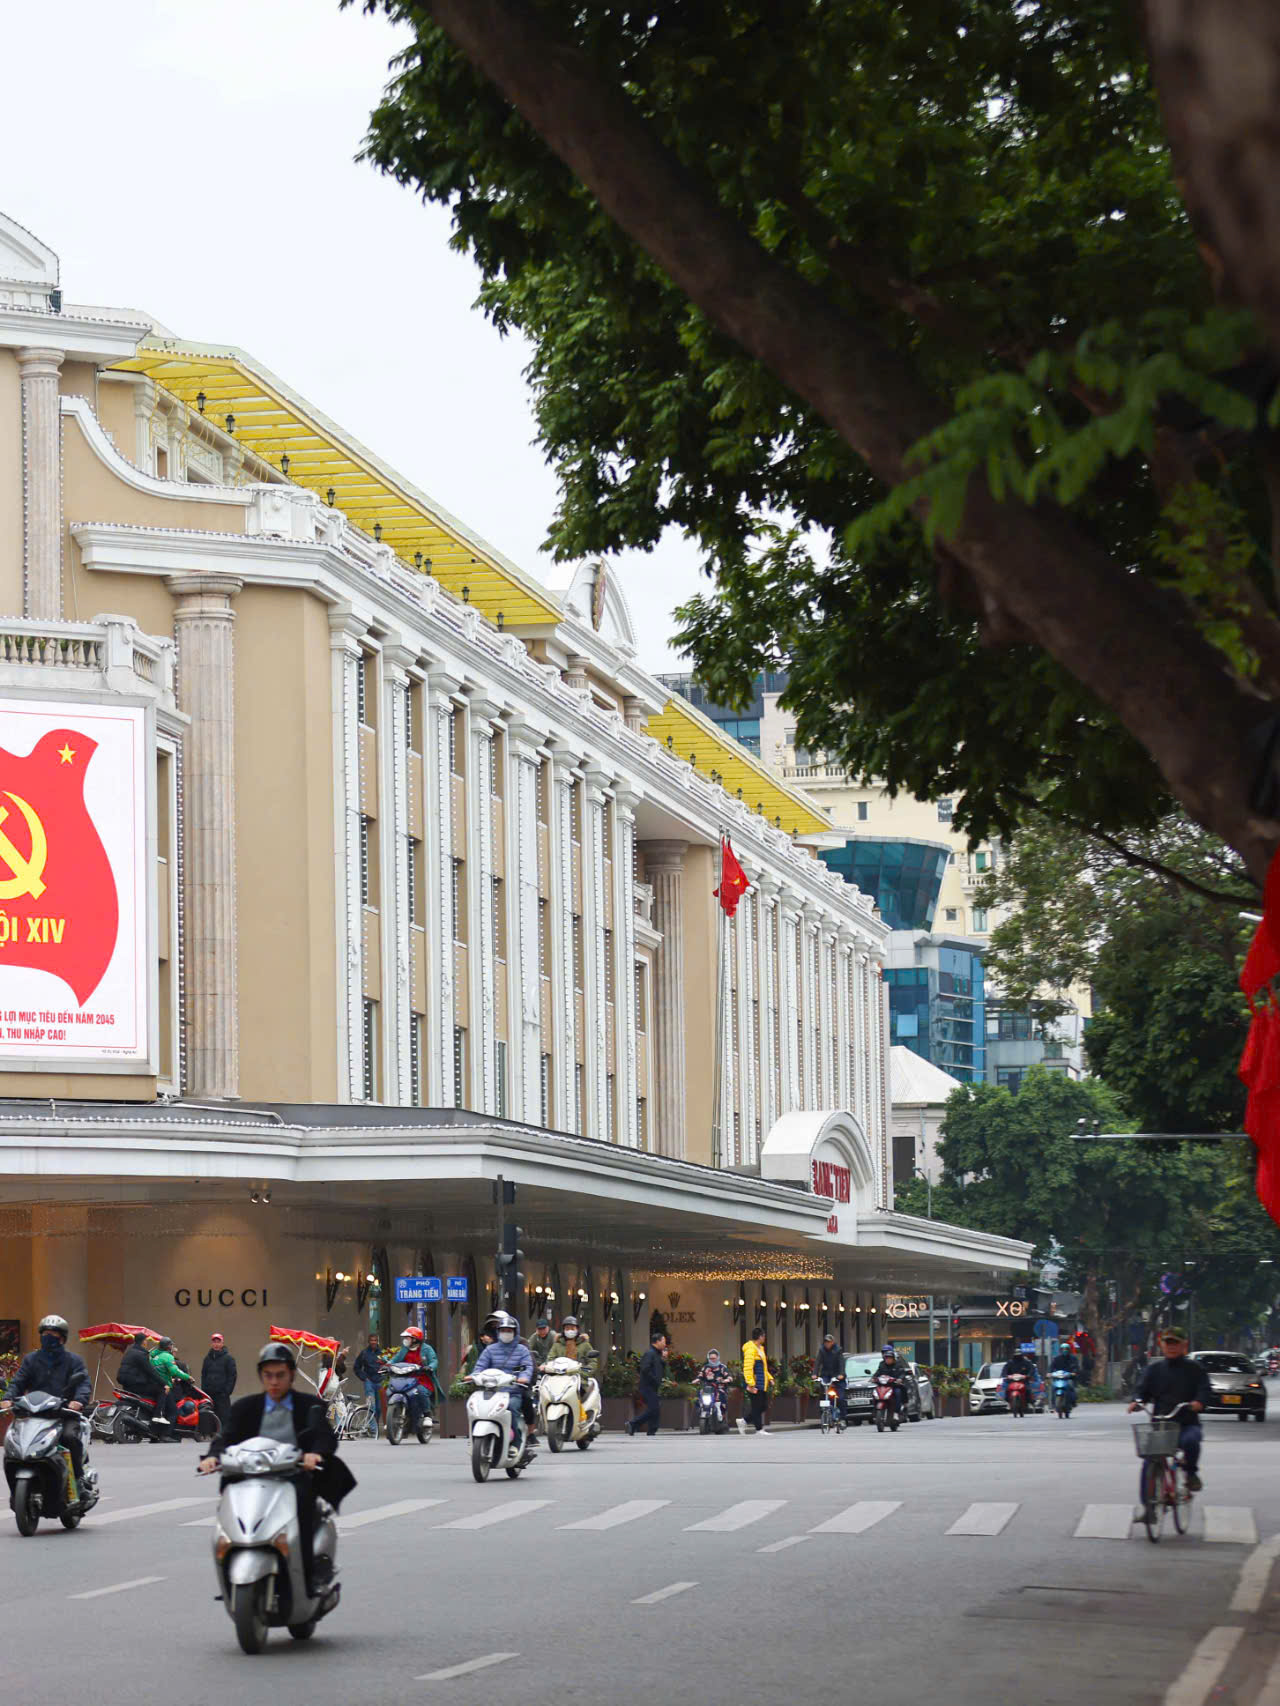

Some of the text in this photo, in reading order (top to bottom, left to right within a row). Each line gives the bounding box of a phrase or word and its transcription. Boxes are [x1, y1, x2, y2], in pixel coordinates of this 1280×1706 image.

[26, 918, 65, 943] XIV
[19, 1011, 37, 1024] MỤC
[39, 1010, 55, 1023] TIÊU
[57, 1009, 73, 1023] ĐẾN
[96, 1014, 115, 1025] 2045
[7, 1028, 21, 1039] THU
[23, 1027, 45, 1042] NHẬP
[48, 1029, 66, 1040] CAO!
[175, 1289, 267, 1306] GUCCI
[663, 1311, 696, 1322] OLEX
